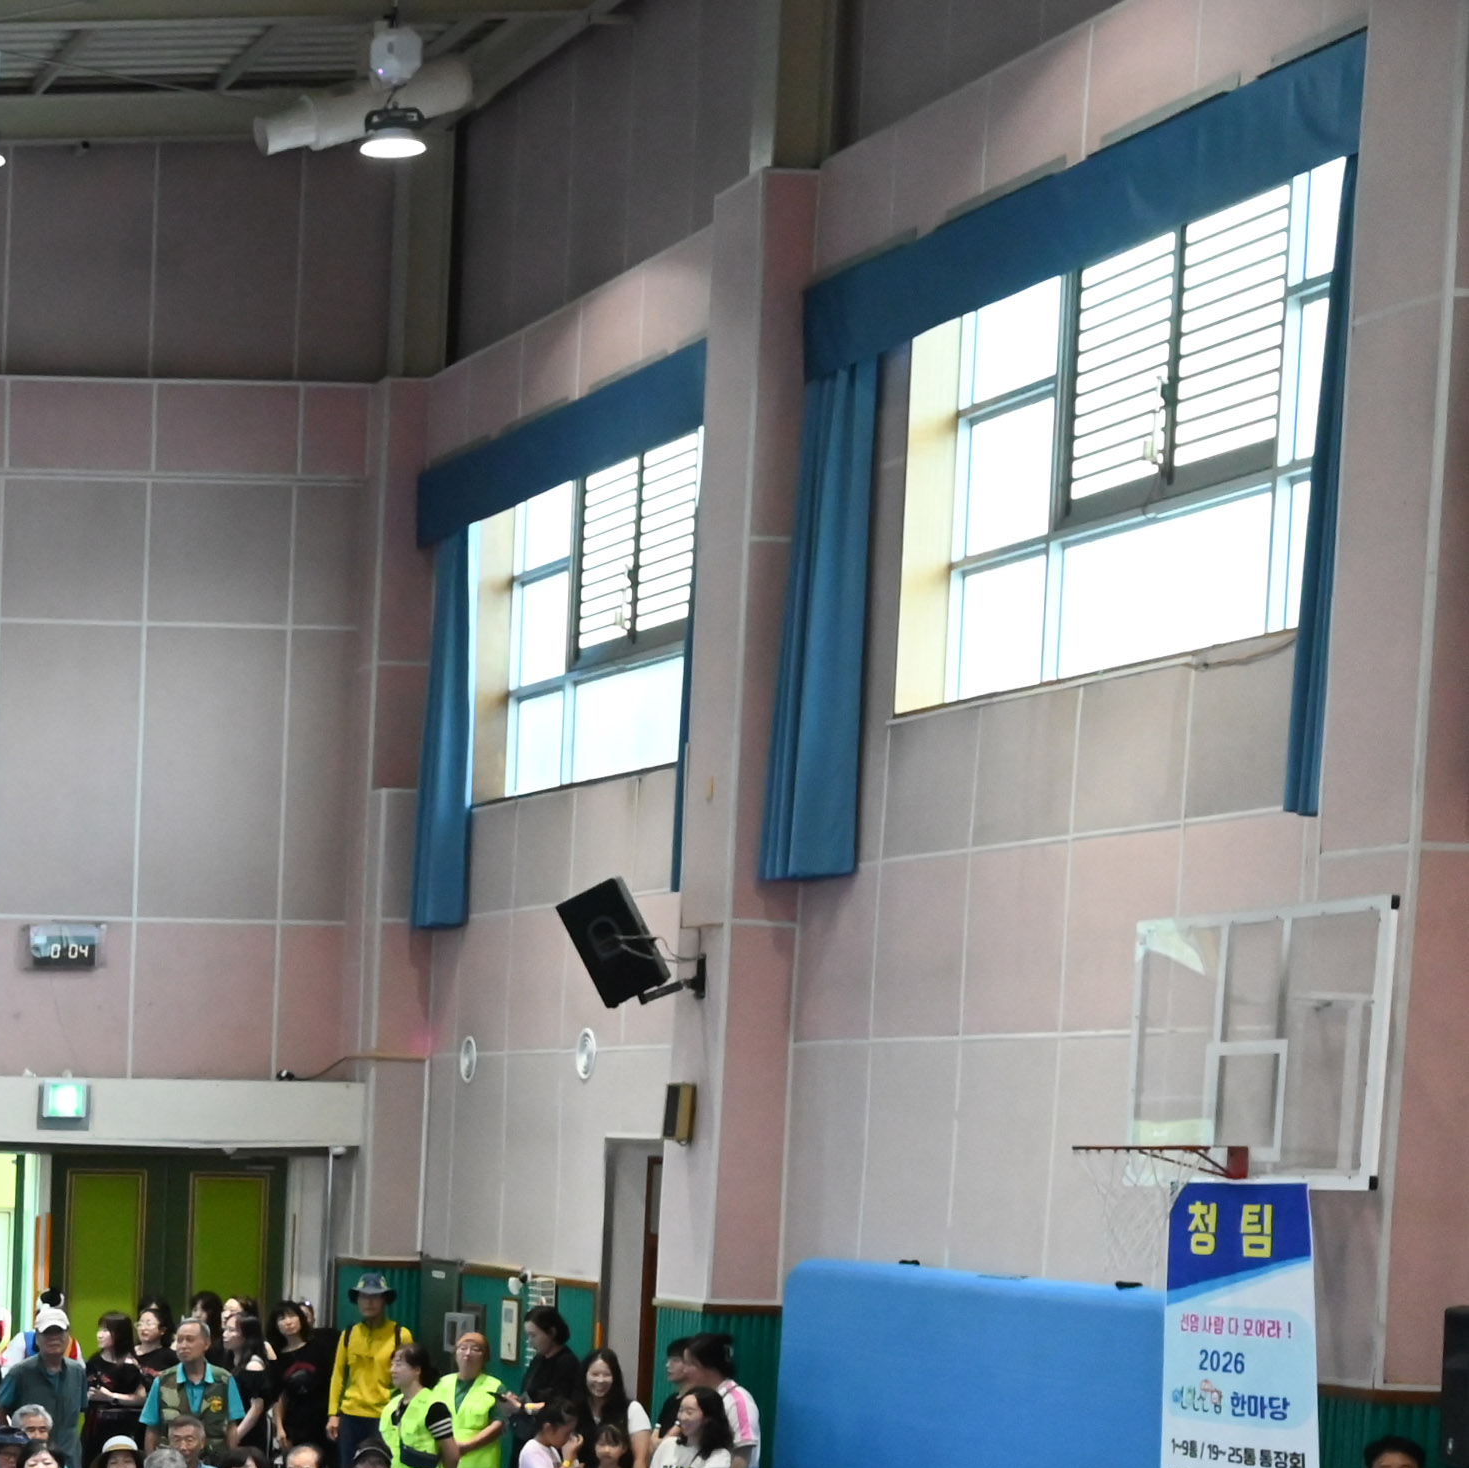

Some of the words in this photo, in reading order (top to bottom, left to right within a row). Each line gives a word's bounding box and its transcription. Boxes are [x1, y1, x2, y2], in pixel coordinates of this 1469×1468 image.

[1203, 1315, 1224, 1335] 사람
[1228, 1317, 1239, 1336] 다
[1243, 1319, 1282, 1339] 모여라
[1199, 1349, 1245, 1375] 2026
[1230, 1391, 1290, 1421] 한마당
